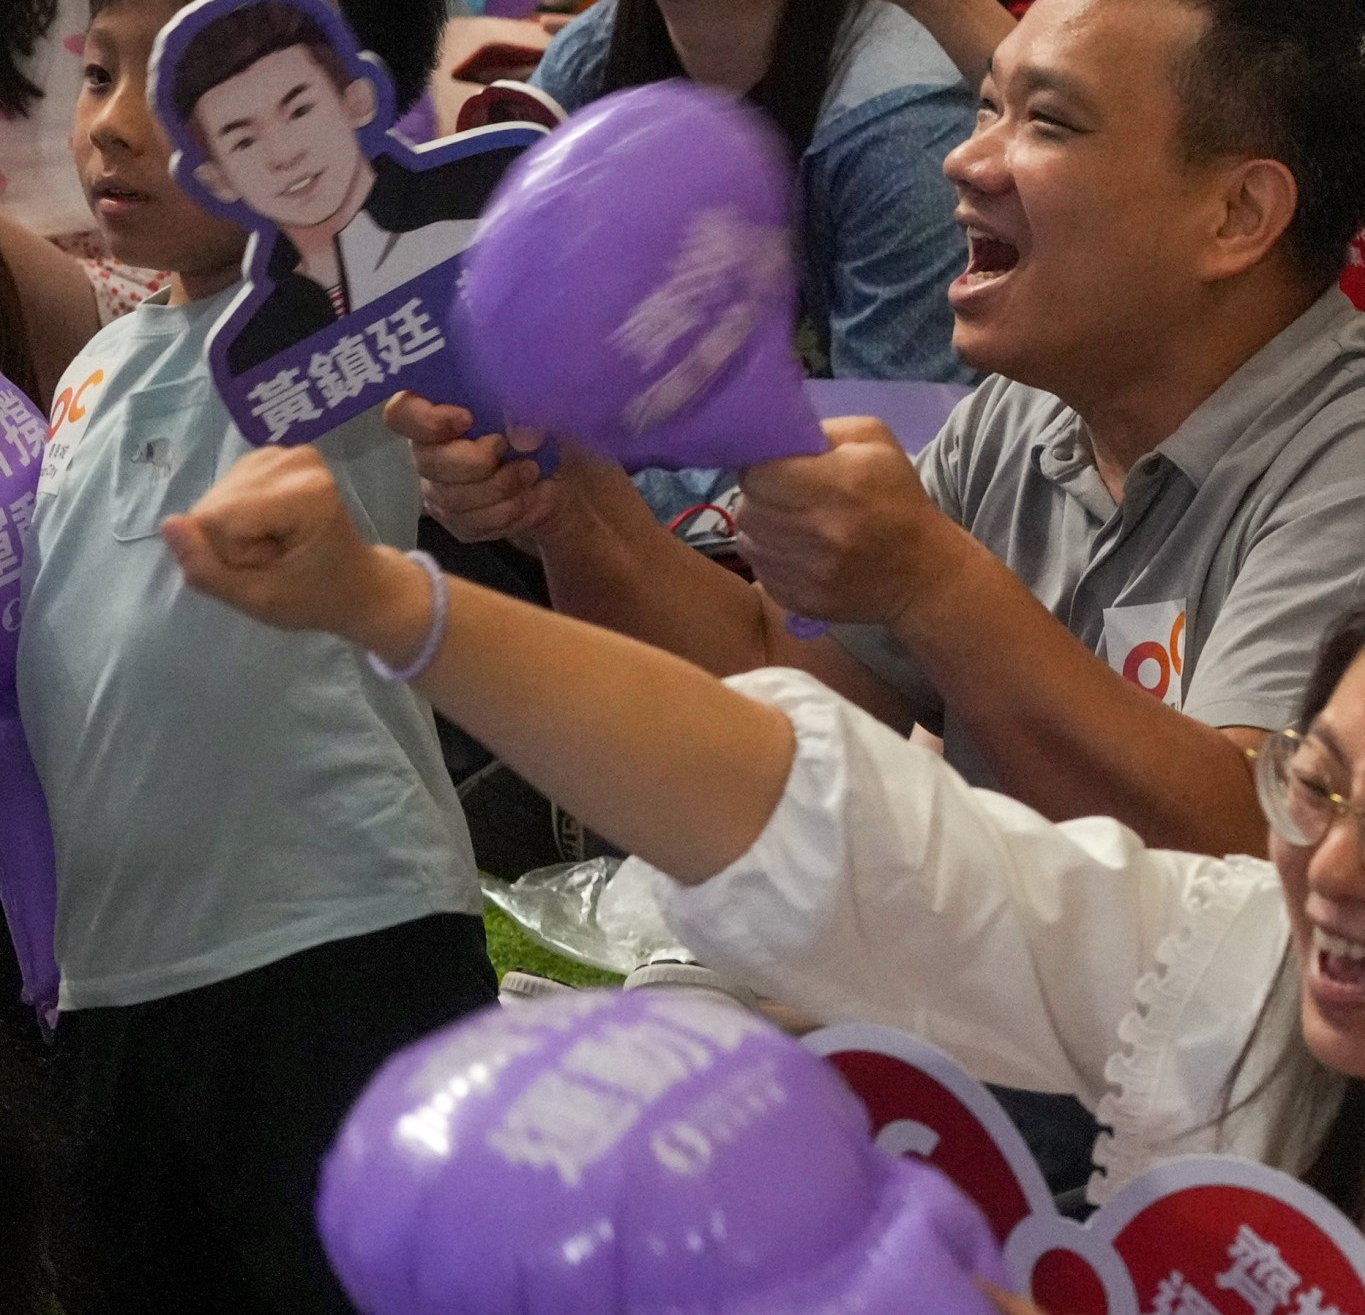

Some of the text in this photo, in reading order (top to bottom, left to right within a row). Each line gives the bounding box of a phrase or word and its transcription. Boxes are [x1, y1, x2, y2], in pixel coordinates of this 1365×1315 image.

[47, 368, 104, 444] OC
[246, 297, 446, 443] 黃鎮廷
[0, 387, 50, 479] 撐
